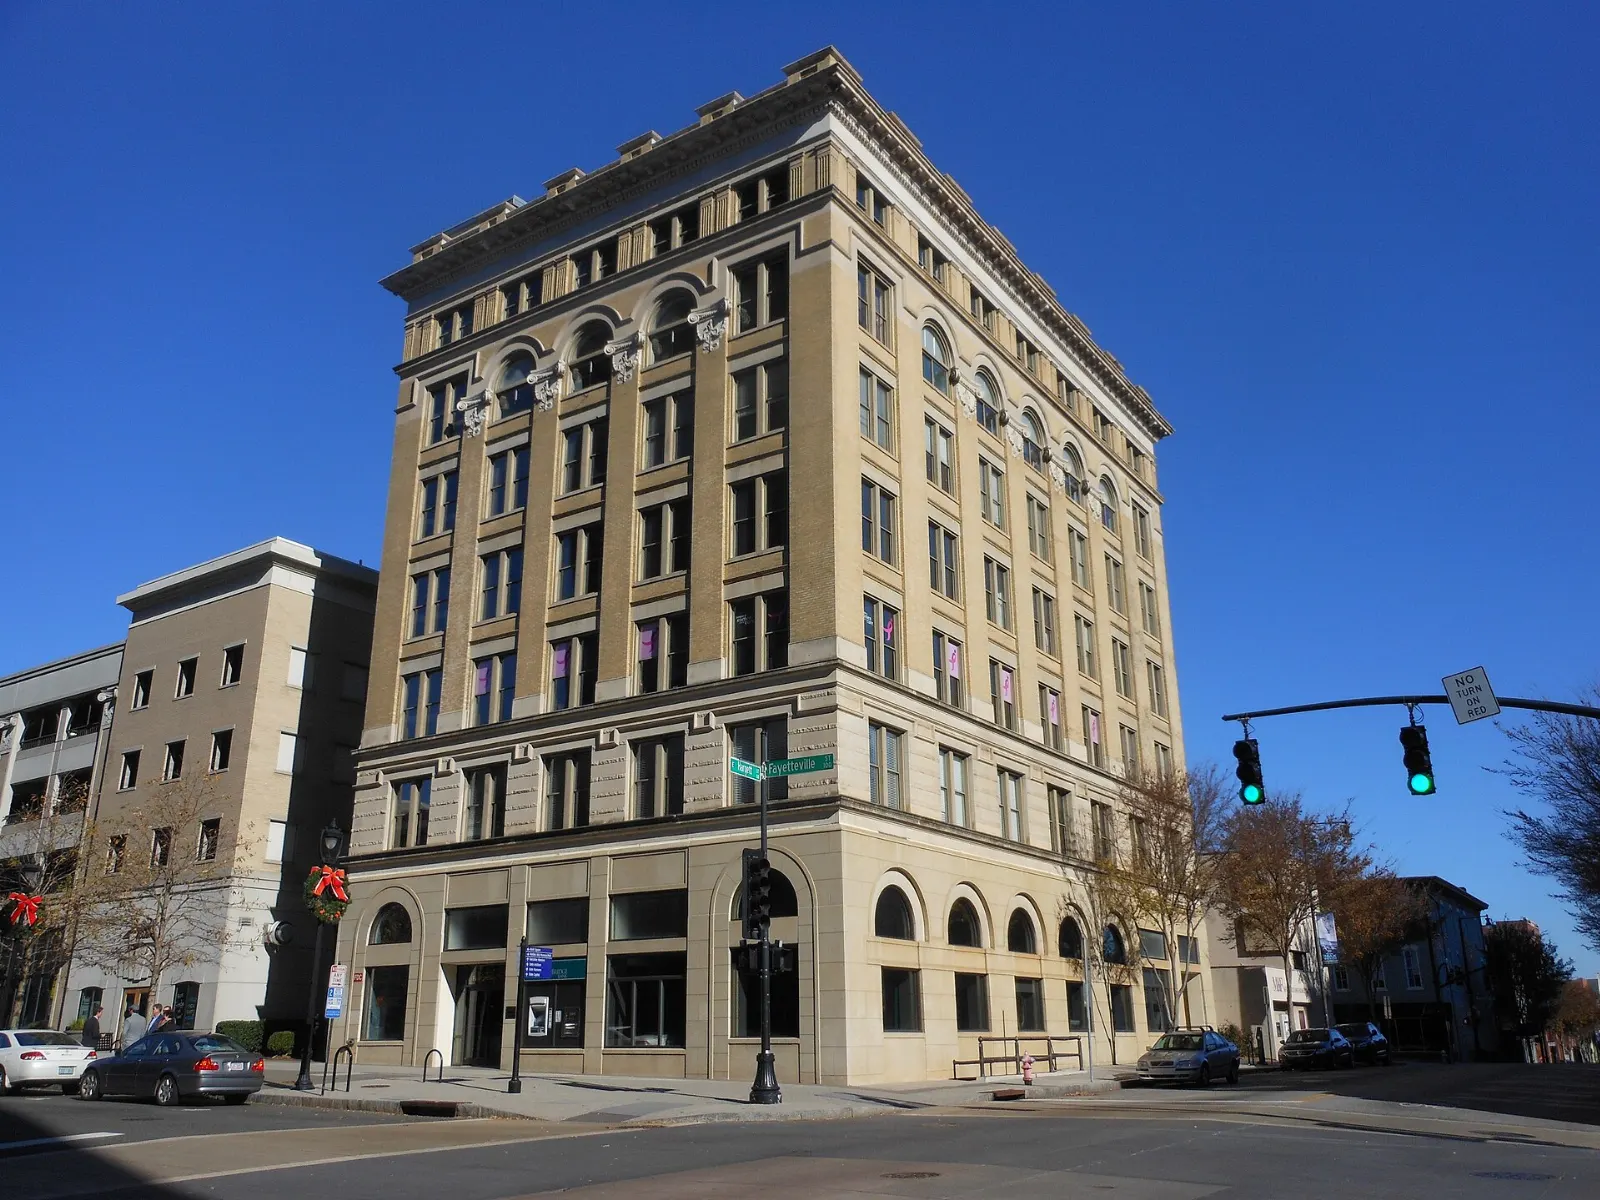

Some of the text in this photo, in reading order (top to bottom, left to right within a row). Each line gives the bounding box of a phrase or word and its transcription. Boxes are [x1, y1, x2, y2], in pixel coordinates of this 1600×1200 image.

[1455, 675, 1474, 687] NO
[1456, 684, 1483, 698] TURN
[1466, 696, 1481, 706] ON
[1467, 705, 1487, 718] RED
[768, 758, 815, 776] Fayetteville
